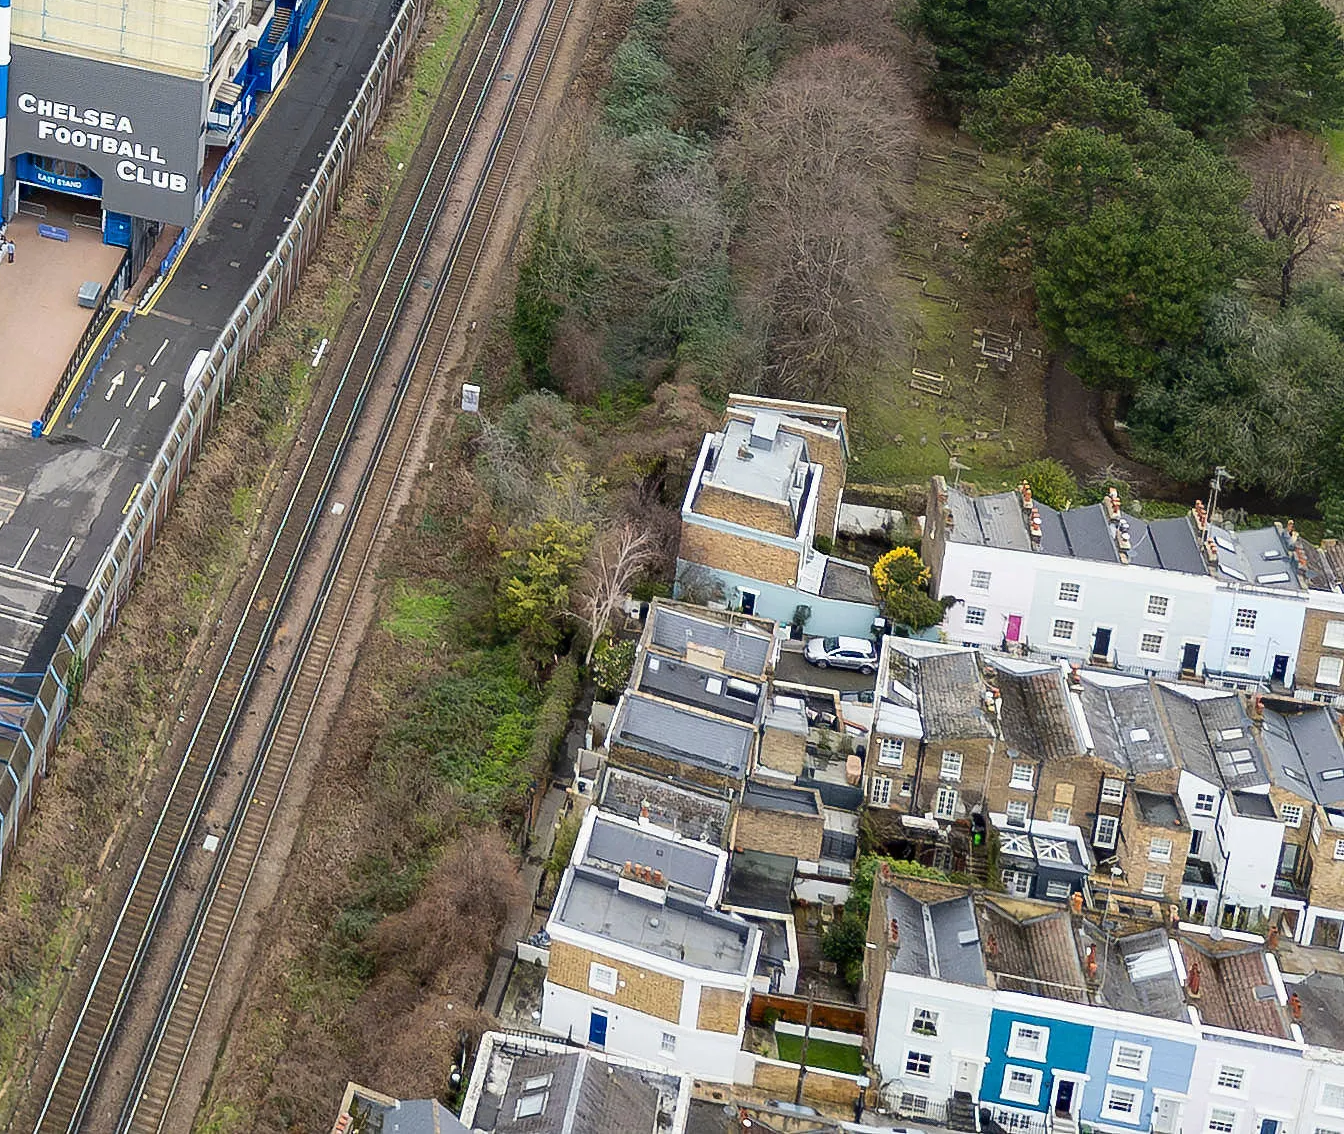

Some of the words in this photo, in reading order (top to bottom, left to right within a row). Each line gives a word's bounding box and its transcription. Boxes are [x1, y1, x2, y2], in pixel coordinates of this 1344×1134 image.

[17, 92, 134, 134] CHELSEA
[38, 120, 167, 165] FOOTBALL
[37, 172, 56, 186] EAST
[56, 176, 83, 189] STAND
[116, 159, 188, 193] CLUB
